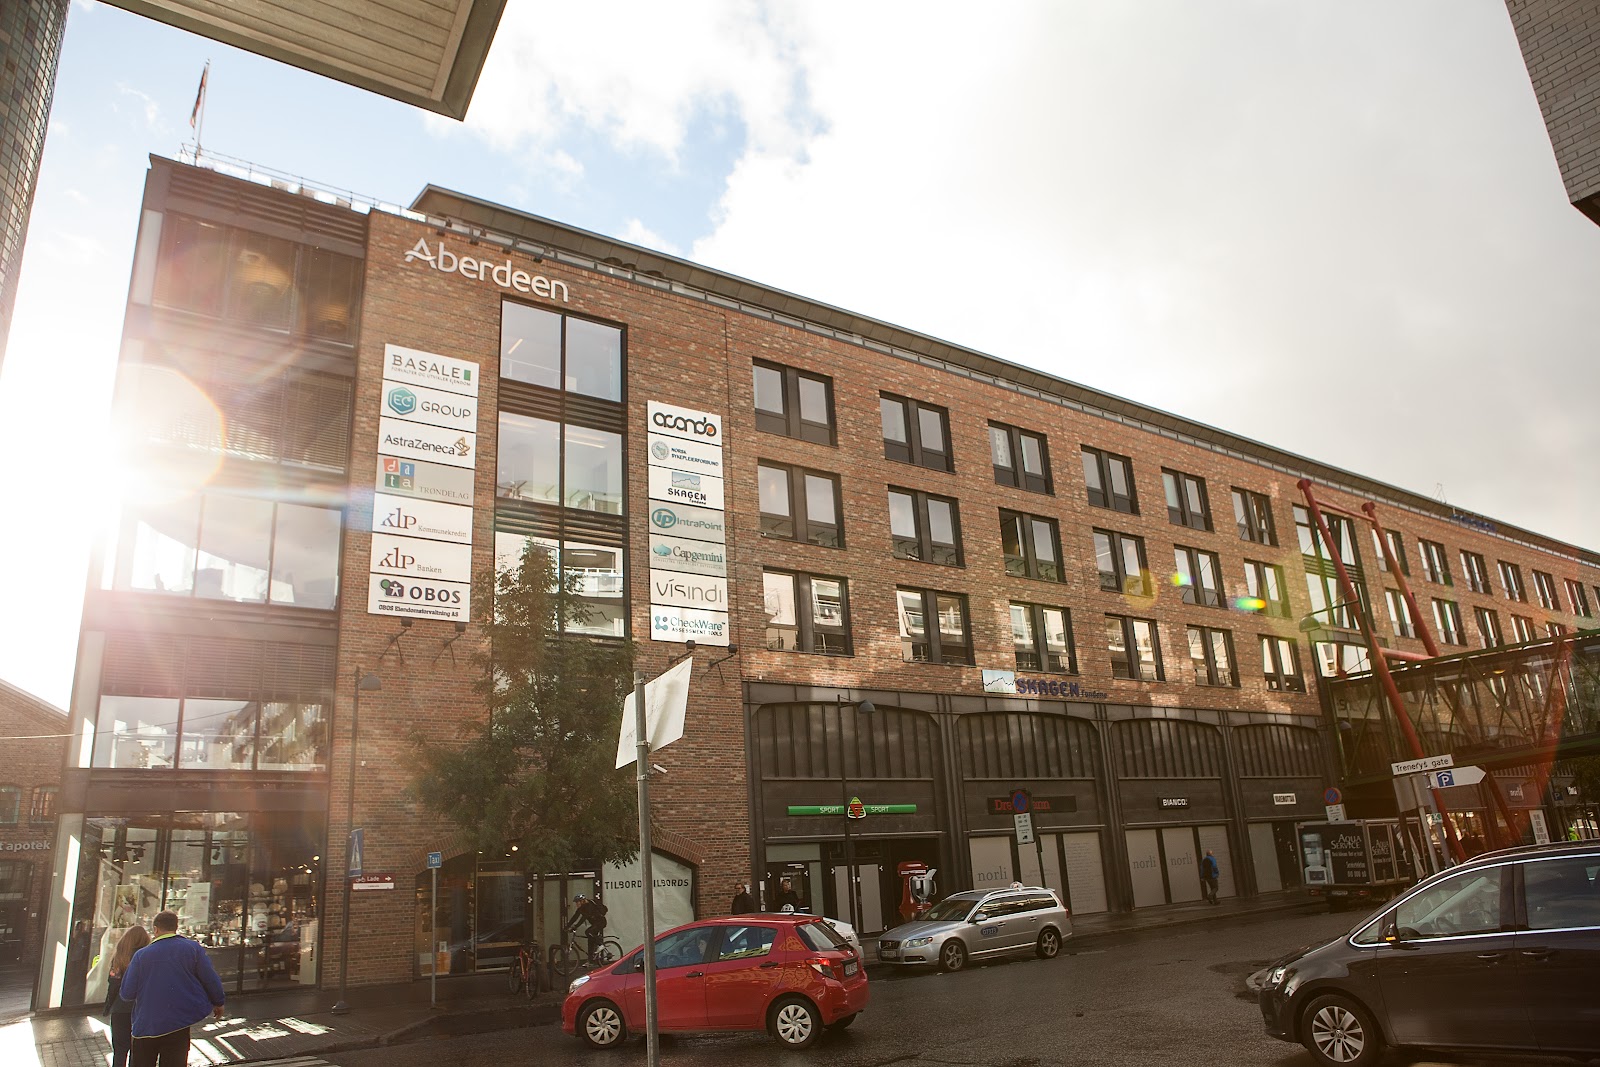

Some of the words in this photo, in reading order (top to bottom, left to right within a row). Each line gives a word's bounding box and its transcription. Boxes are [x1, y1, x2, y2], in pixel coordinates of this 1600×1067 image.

[404, 237, 569, 303] Aberdeen
[392, 354, 460, 379] BASALE
[421, 401, 471, 419] GROUP
[652, 411, 717, 437] acando
[384, 434, 455, 455] AstraZeneca
[419, 486, 469, 500] TRØNDELAG
[667, 487, 707, 501] SKAGEN
[418, 525, 467, 538] Kommunekreditt
[676, 517, 723, 532] IntraPoint
[672, 545, 723, 563] Capgemini
[416, 564, 442, 574] Banken
[409, 586, 461, 604] OBOS
[671, 627, 706, 635] ASSESSMENT
[1016, 677, 1080, 698] SKAGEN
[1395, 761, 1428, 772] Trenerys
[1431, 758, 1449, 768] gate
[1441, 775, 1450, 787] P
[819, 806, 840, 814] SPORT
[994, 799, 1051, 811] Dreann
[6, 840, 51, 852] apotek
[428, 854, 440, 864] Taxi
[1133, 855, 1157, 870] norli
[1170, 853, 1193, 866] norli
[977, 865, 1008, 882] norli
[605, 880, 642, 889] TILBORD
[653, 879, 689, 888] ILBORDS
